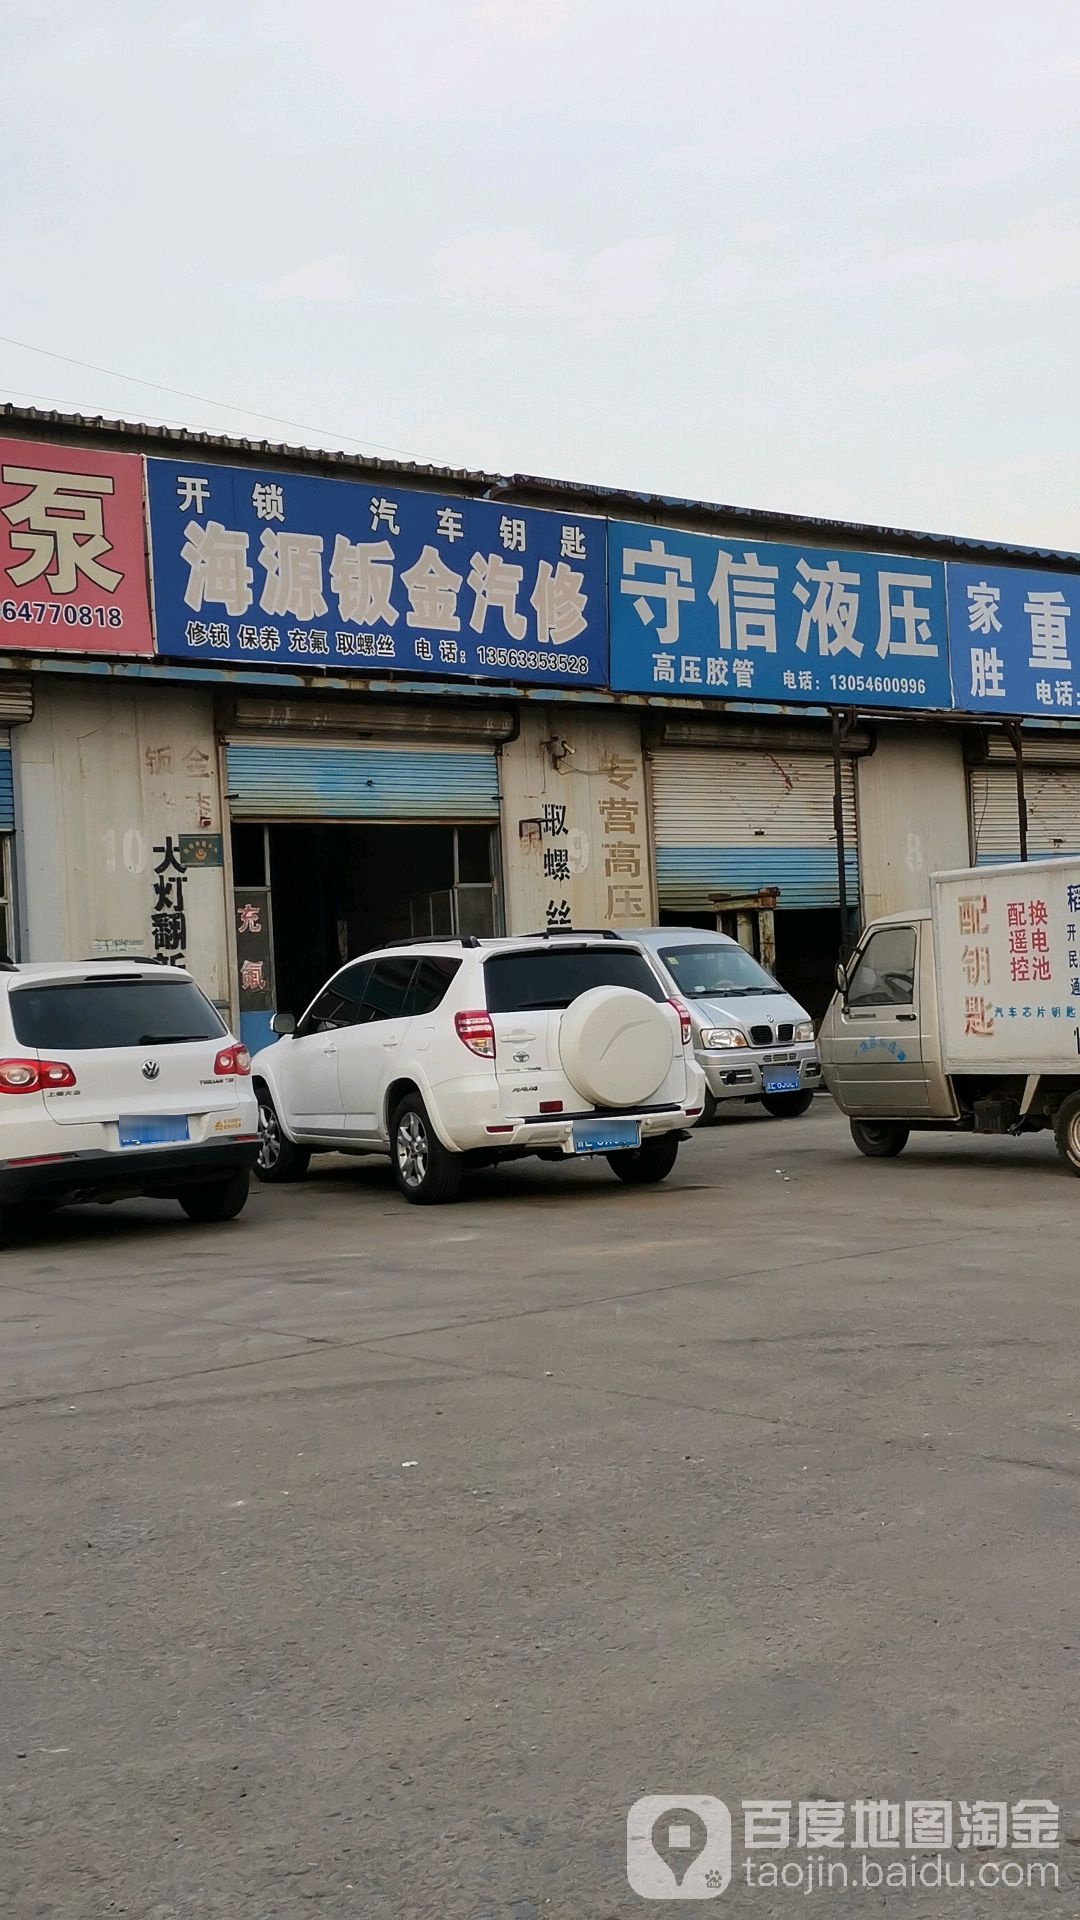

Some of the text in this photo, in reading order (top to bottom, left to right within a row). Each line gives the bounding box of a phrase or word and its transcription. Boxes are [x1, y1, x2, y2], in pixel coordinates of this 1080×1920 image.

[1, 465, 125, 594] 泵
[177, 476, 587, 560] 开锁 汽车钥匙
[2, 600, 123, 628] 64770818
[180, 520, 588, 645] 海源钣金汽修
[620, 539, 939, 659] 守信液压
[1024, 591, 1072, 670] 重
[185, 621, 230, 648] 修锁
[237, 624, 281, 651] 保养
[336, 632, 396, 657] 取螺丝
[477, 646, 589, 674] 13563353528
[652, 652, 754, 688] 高压胶管
[830, 674, 926, 694] 13054600996
[542, 803, 571, 925] 取螺丝
[598, 754, 646, 920] 专营高压
[957, 895, 995, 1037] 配钥匙
[994, 1006, 1076, 1018] 汽车芯片钥匙
